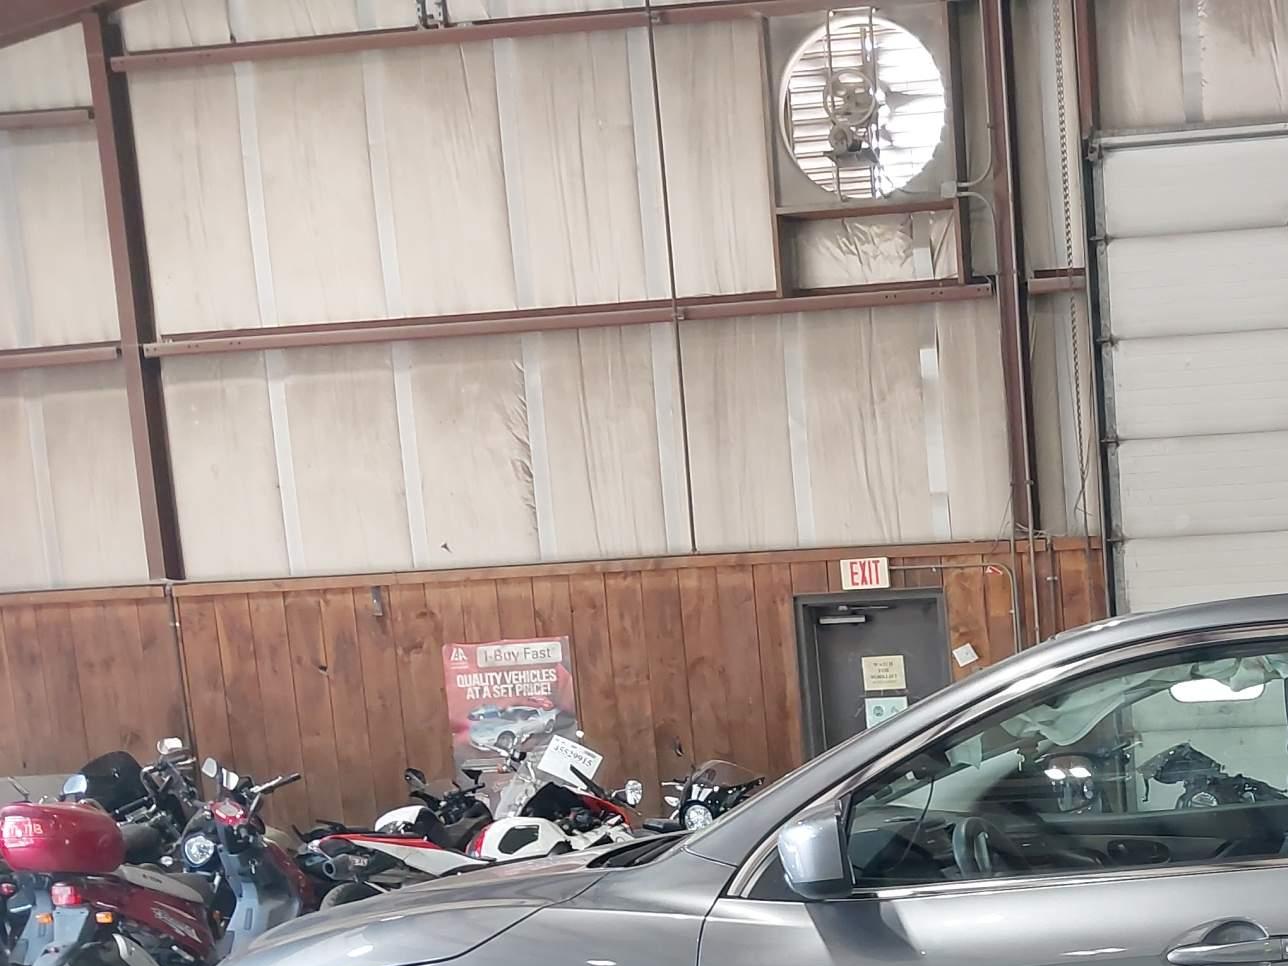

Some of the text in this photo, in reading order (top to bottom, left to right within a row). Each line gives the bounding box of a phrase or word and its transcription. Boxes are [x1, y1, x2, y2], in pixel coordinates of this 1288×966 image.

[849, 559, 880, 586] EXIT
[484, 647, 552, 663] I-Buy Fast
[456, 669, 557, 687] QUALITY VEHICLES
[466, 682, 552, 700] AT A SET PRICE!
